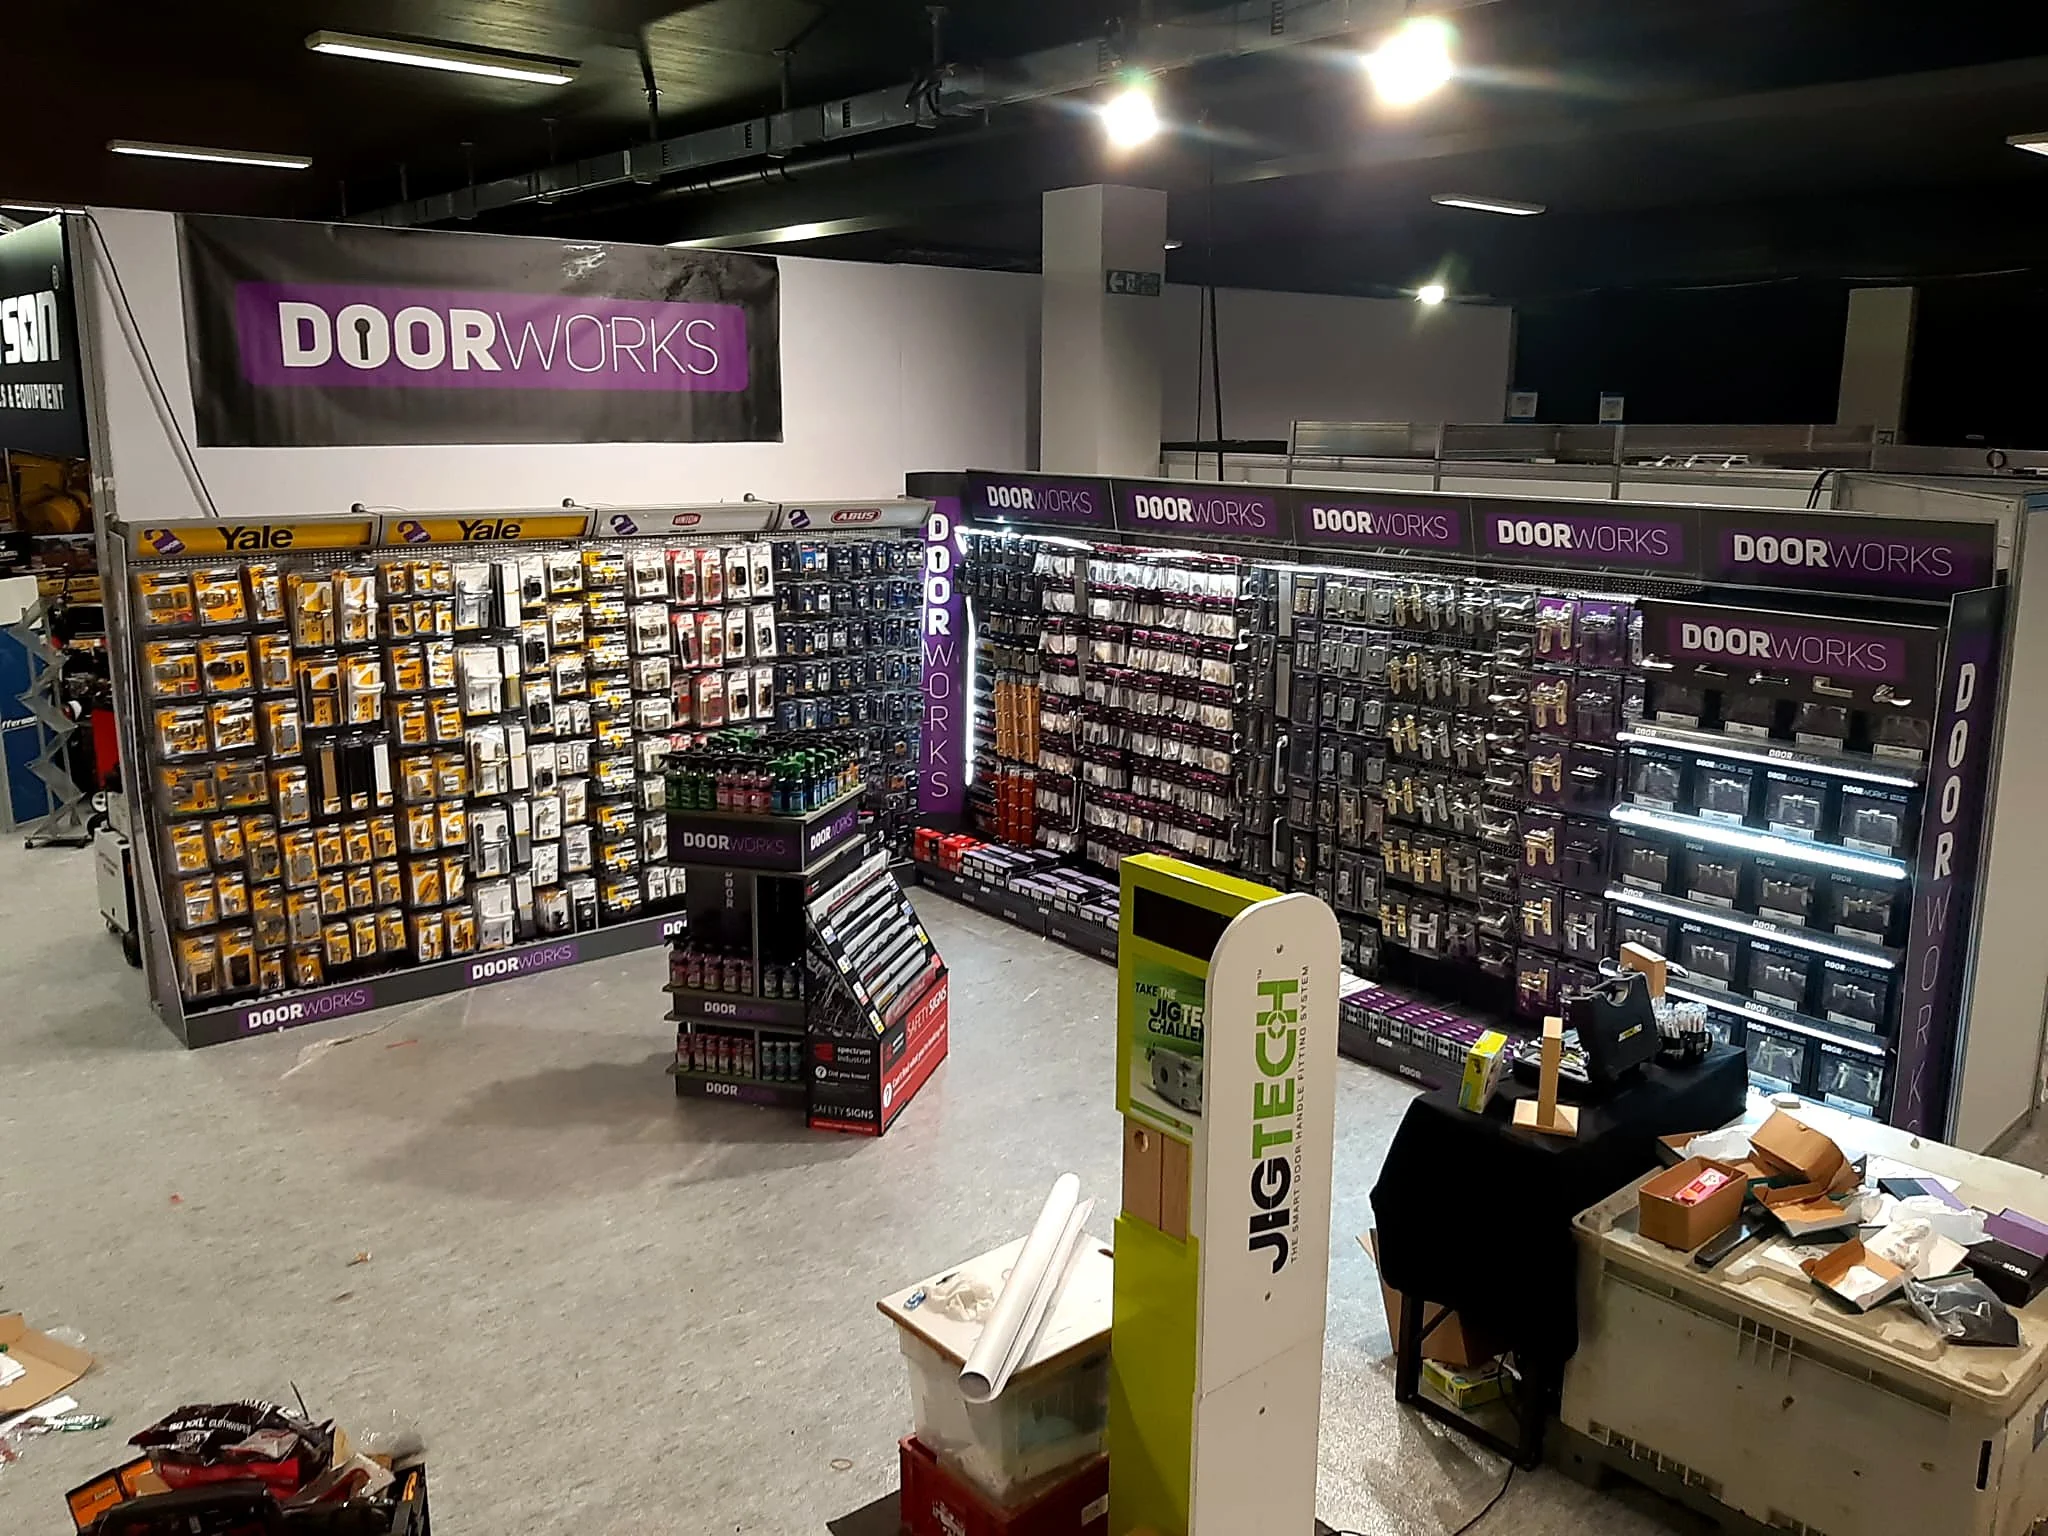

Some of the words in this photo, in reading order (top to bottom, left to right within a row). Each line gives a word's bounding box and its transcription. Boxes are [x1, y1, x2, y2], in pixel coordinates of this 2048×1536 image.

[278, 301, 720, 376] DOORWORKS
[14, 383, 64, 409] EQUIPMENT
[837, 510, 876, 522] ABUS
[986, 486, 1093, 514] DOORWORKS
[1134, 495, 1267, 528] DOORWORKS
[217, 525, 294, 551] Yale
[458, 518, 522, 542] Yale
[1312, 508, 1450, 540] DOORWORKS
[1496, 519, 1670, 556] DOORWORKS
[1733, 534, 1954, 577] DOORWORKS
[923, 513, 954, 799] DOORWORKS
[1680, 622, 1888, 672] DOORWORKS
[683, 832, 785, 856] DOORWORKS
[810, 814, 853, 851] DOORWORKS
[472, 945, 572, 981] DOORWORKS
[1136, 982, 1158, 996] TAKE
[1160, 986, 1177, 1000] THE
[1300, 965, 1309, 1021] SYSTEM
[247, 991, 366, 1030] DOORWORKS
[837, 1046, 871, 1056] spectrum
[1298, 1027, 1307, 1081] FITTING
[1249, 979, 1299, 1275] JIGTECH
[1296, 1086, 1305, 1140] HANDLE
[1294, 1144, 1302, 1182] DOOR
[1292, 1190, 1301, 1232] SMART
[1291, 1237, 1299, 1264] THE
